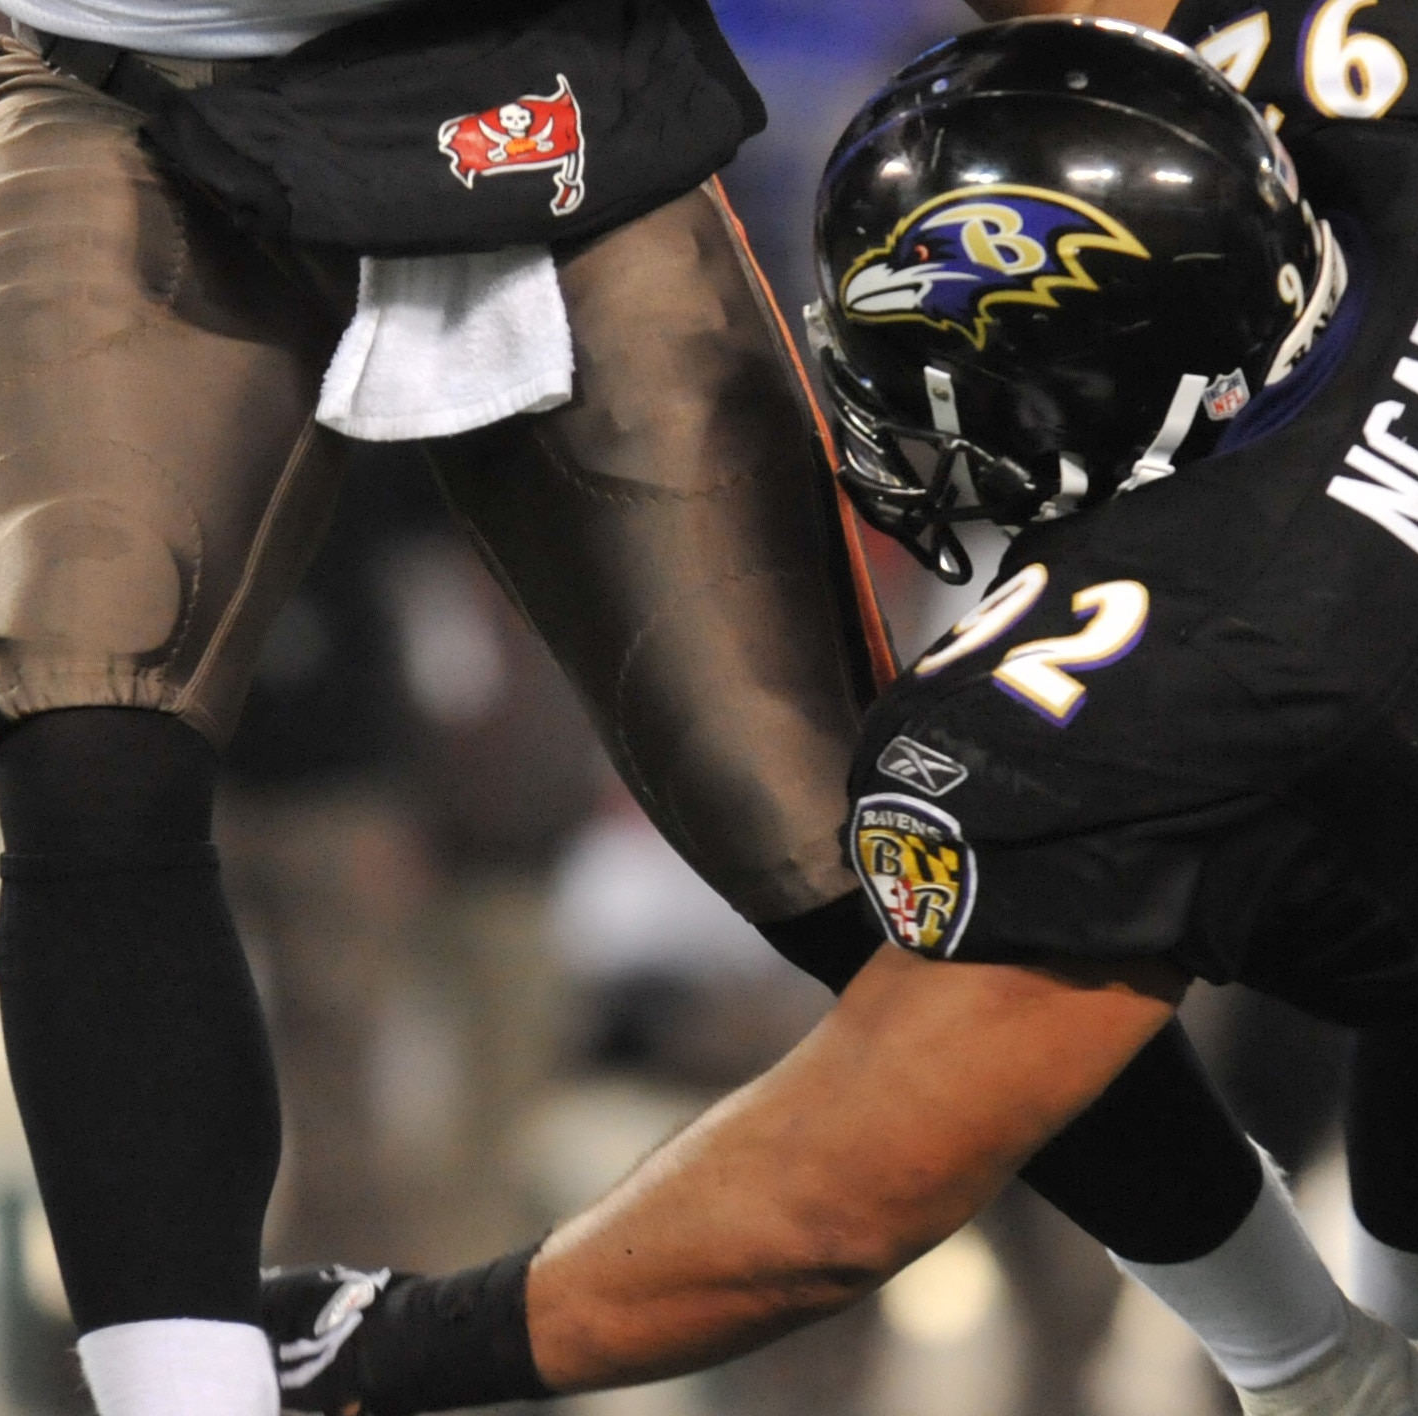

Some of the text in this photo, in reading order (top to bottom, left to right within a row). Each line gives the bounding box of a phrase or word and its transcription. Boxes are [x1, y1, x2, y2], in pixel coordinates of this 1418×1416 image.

[921, 202, 1047, 276] B
[1211, 388, 1243, 416] NFL
[914, 562, 1151, 730] 92
